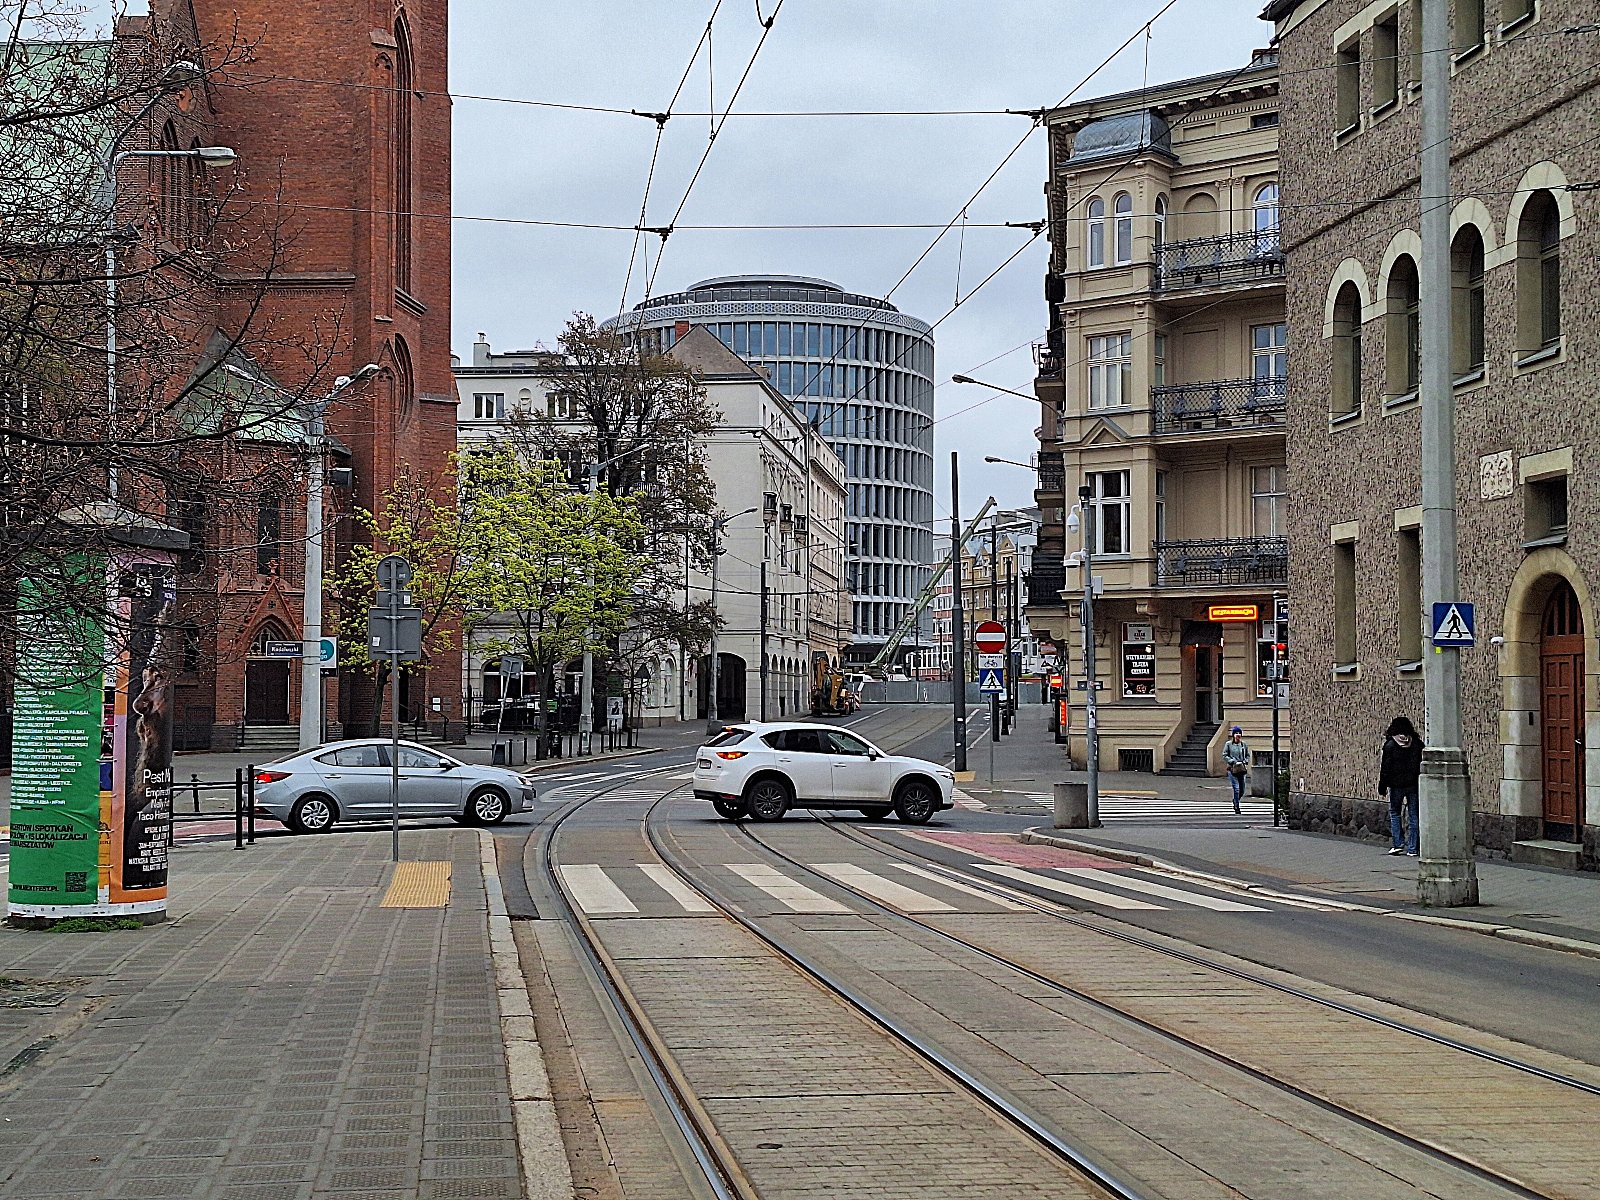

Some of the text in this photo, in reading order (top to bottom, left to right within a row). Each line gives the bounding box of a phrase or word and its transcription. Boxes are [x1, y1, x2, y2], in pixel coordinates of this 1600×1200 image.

[137, 810, 154, 821] Taco
[36, 824, 74, 832] SPOTKAŃ
[36, 833, 88, 841] LOKALIZACJI
